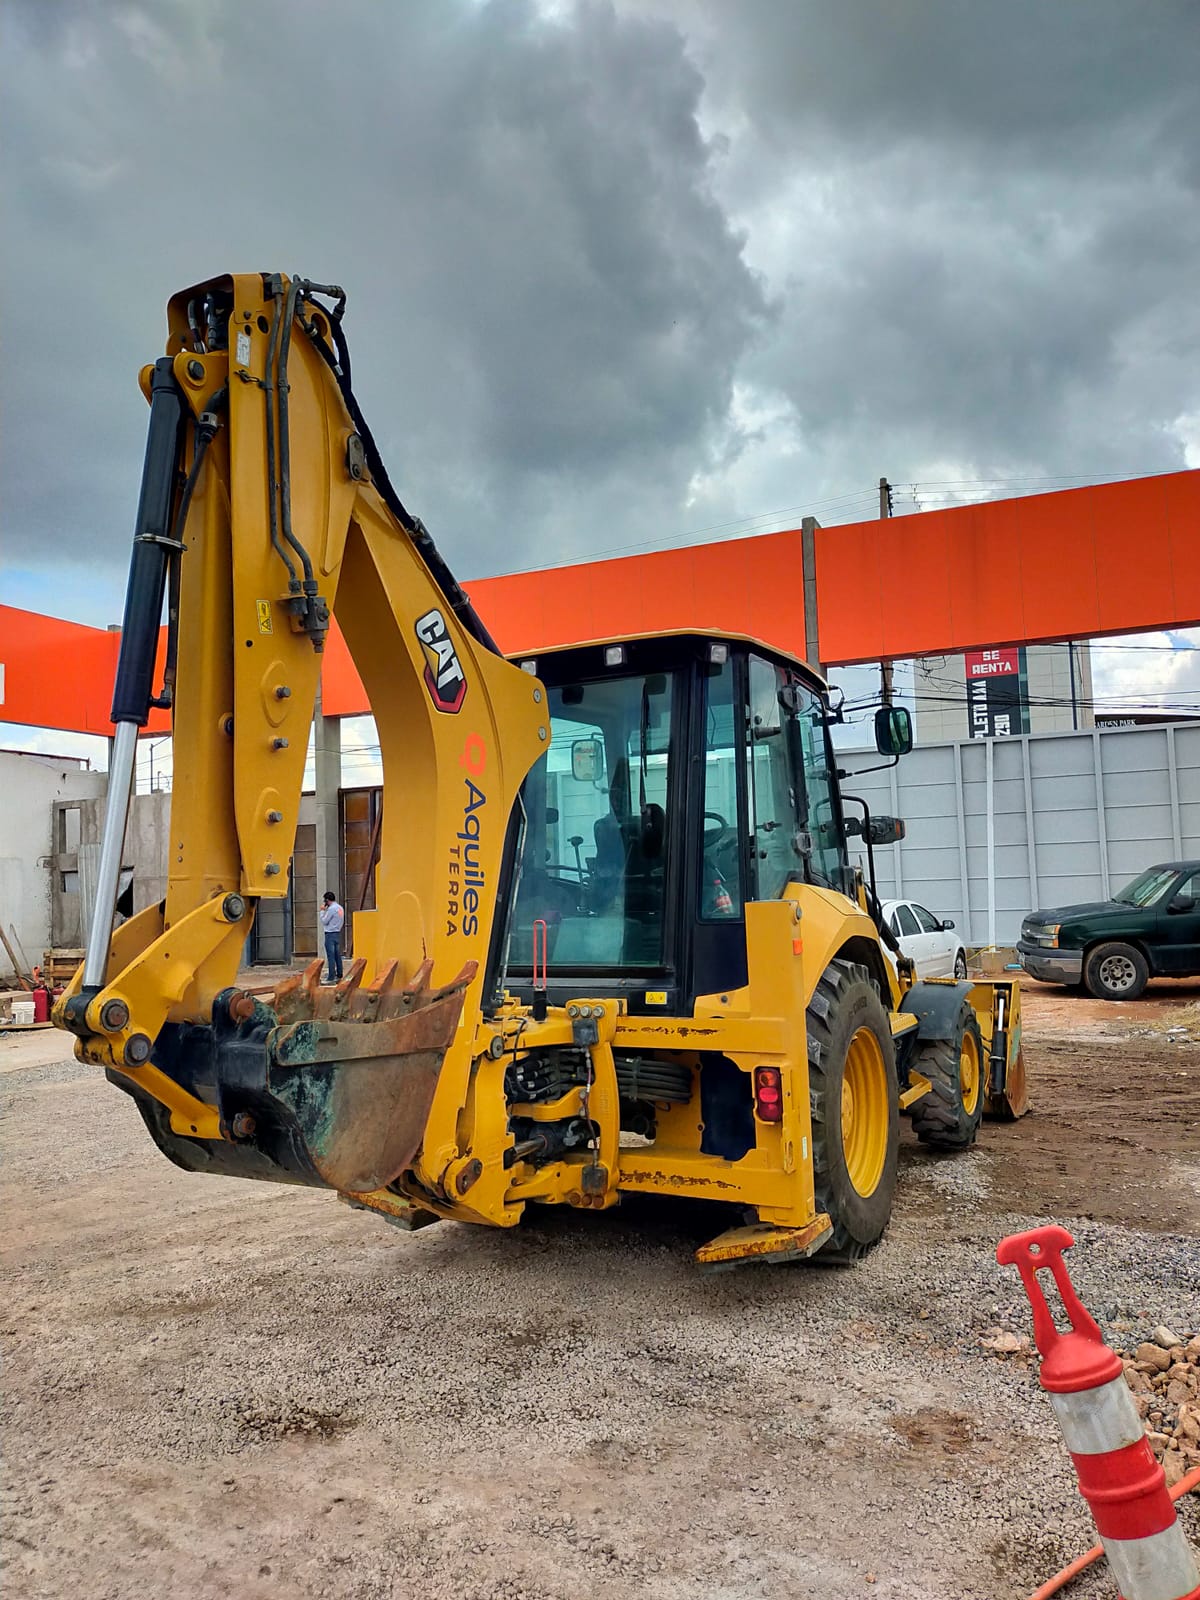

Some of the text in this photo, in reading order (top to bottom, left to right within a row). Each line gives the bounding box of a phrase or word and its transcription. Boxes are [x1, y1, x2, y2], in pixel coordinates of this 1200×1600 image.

[416, 610, 464, 689] CAT
[972, 662, 1012, 674] RENTA
[982, 650, 1000, 661] SE
[1119, 718, 1137, 727] PARK
[457, 778, 487, 936] Aquiles
[446, 845, 460, 937] TERRA
